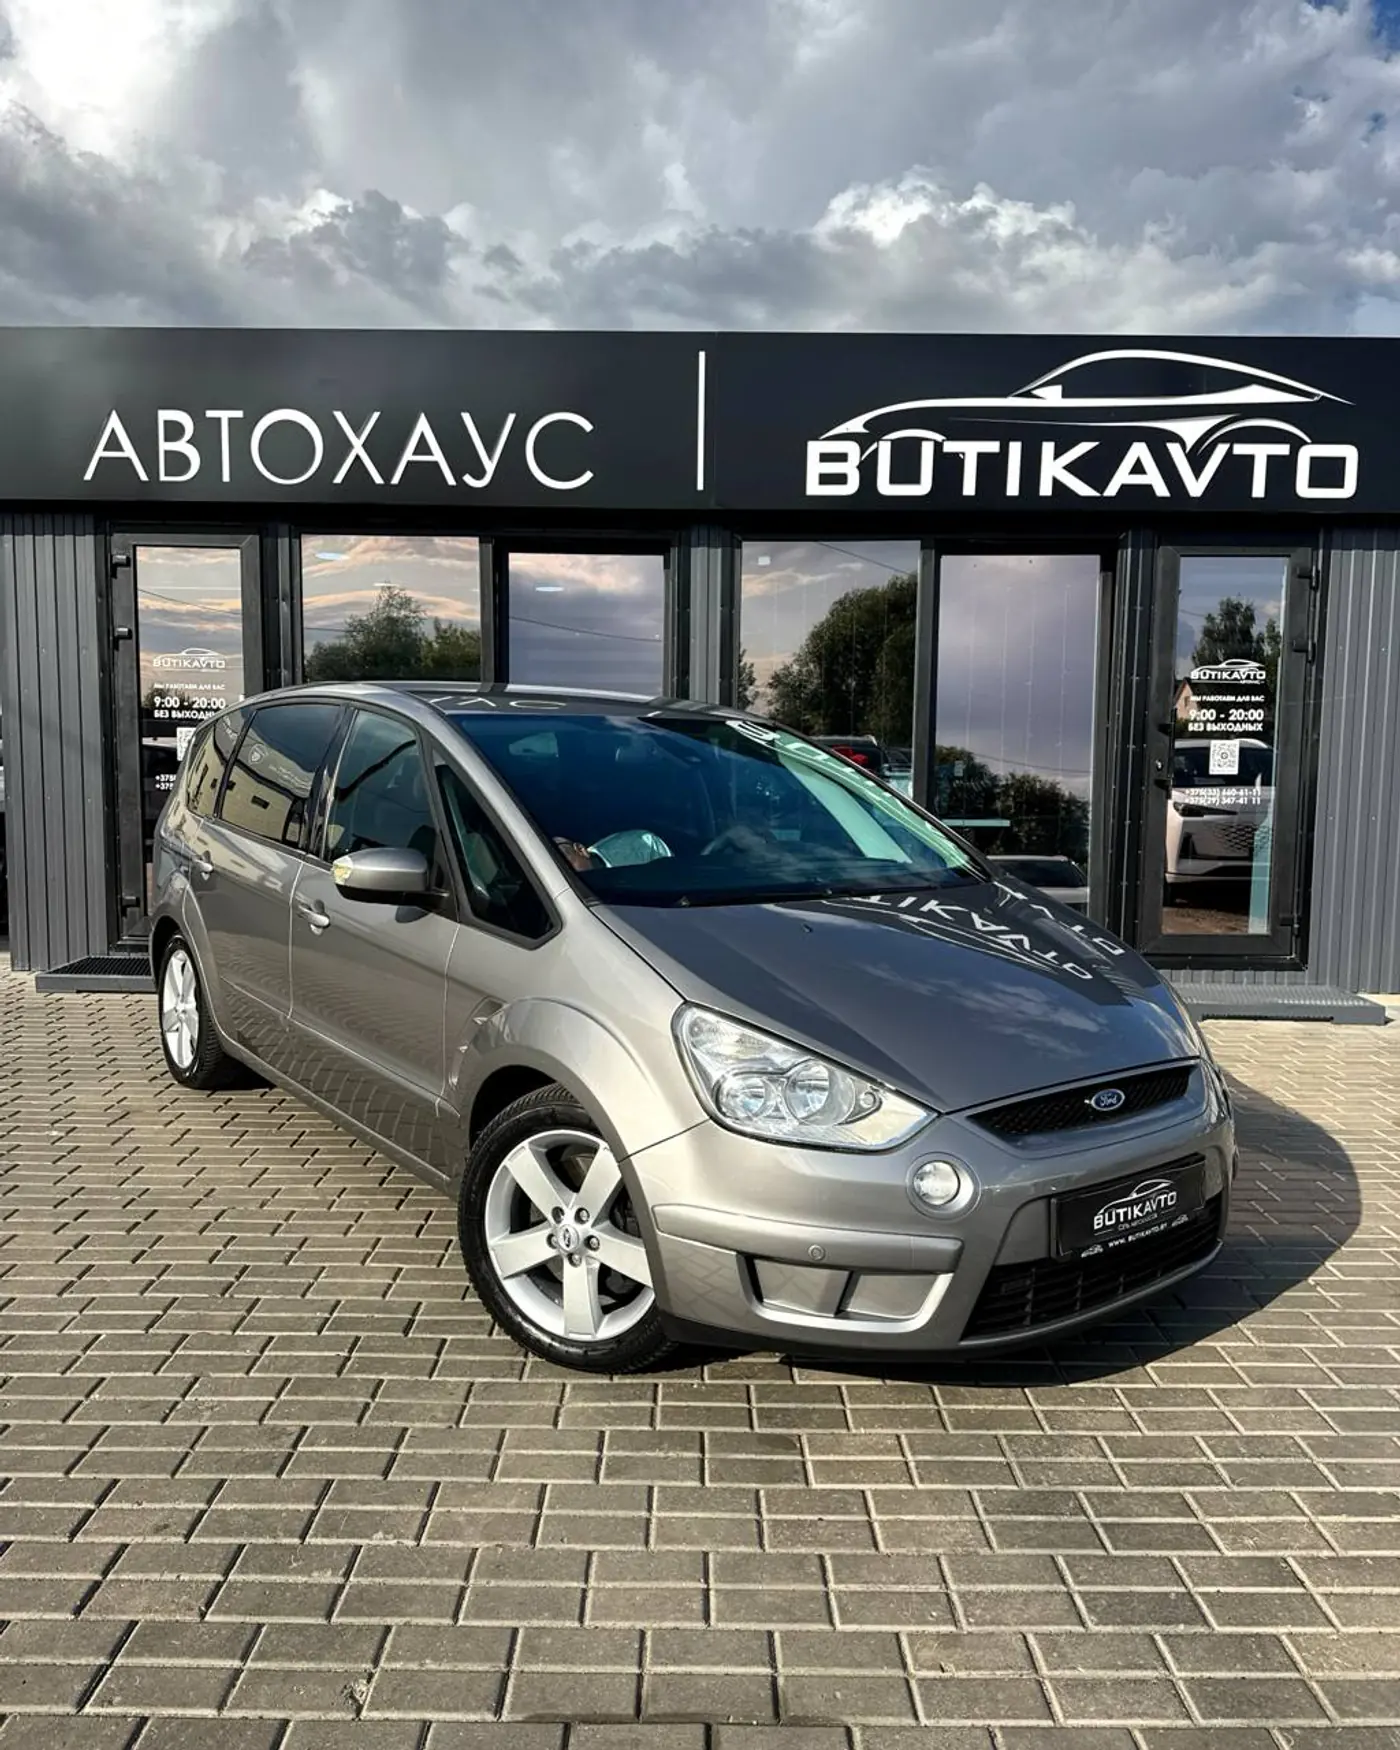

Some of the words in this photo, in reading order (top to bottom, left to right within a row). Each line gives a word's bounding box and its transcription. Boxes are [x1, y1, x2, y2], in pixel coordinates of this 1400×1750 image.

[83, 408, 595, 490] АВТОХАУС
[806, 439, 1358, 499] BUTIKAVTO
[153, 658, 226, 669] BUTIKAVTO
[1190, 671, 1266, 680] BUTIKAVTO
[153, 695, 181, 708] 9:00
[192, 696, 226, 709] 20:00
[154, 709, 170, 719] БЕЗ
[1188, 708, 1217, 721] 9:00
[1228, 708, 1264, 721] 20:00
[1206, 722, 1264, 733] ВЫХОДНЫХ
[1093, 1191, 1177, 1230] BUTIKAVTO
